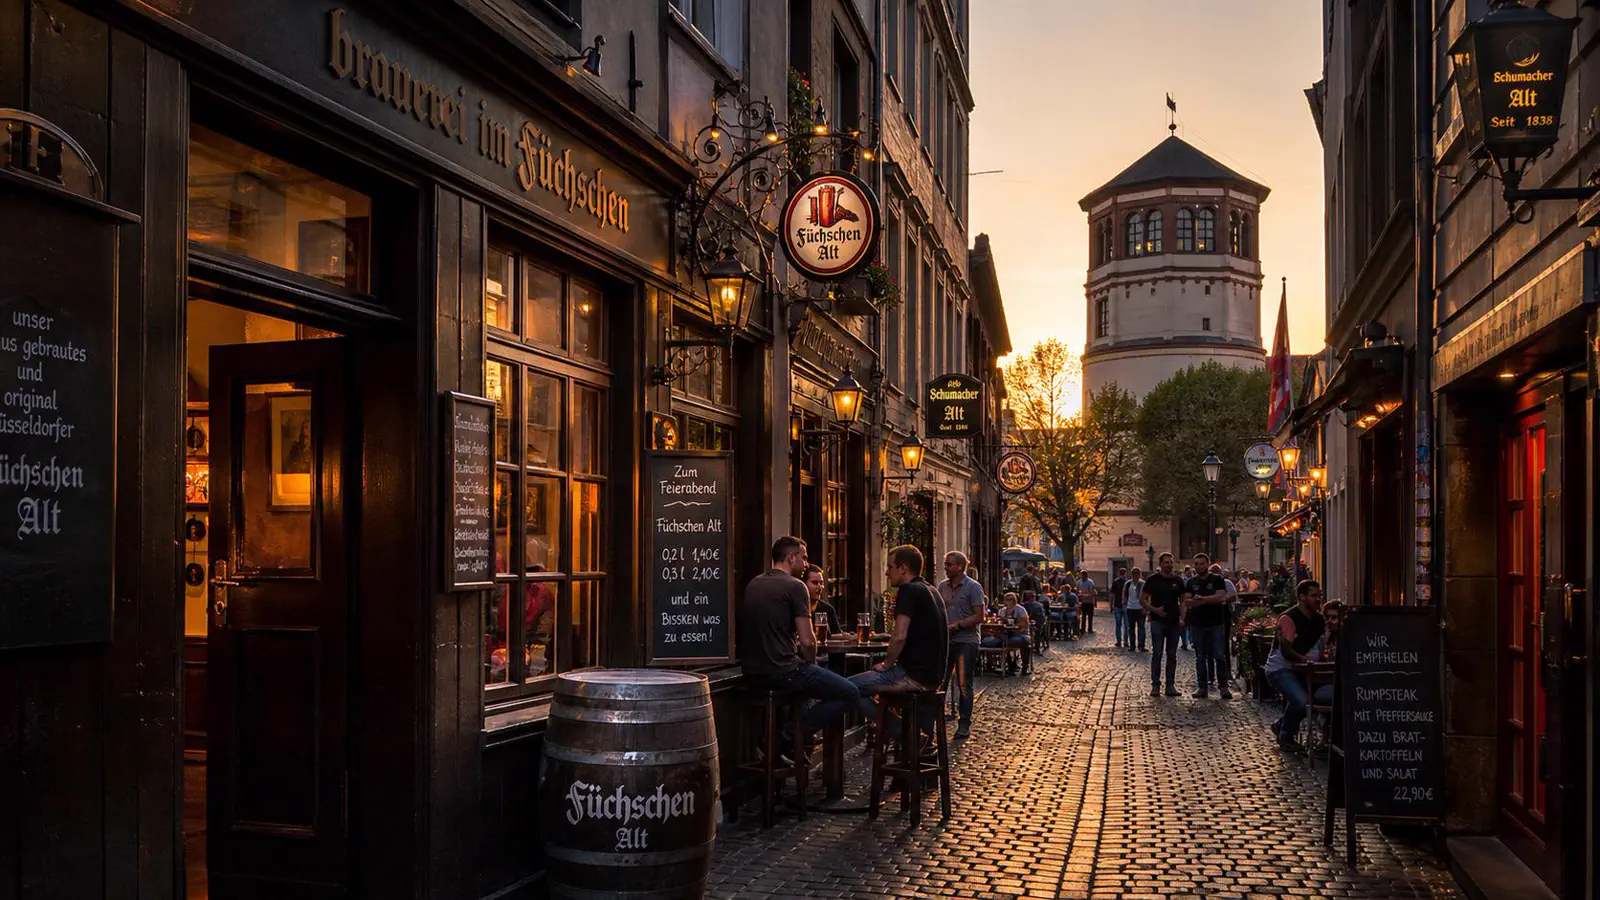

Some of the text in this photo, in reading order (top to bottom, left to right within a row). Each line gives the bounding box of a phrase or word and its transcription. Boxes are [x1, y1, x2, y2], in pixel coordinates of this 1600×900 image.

[1493, 70, 1554, 83] Schumacher
[1508, 88, 1537, 108] Alt
[328, 8, 629, 233] brauerei im Füchschen
[1491, 115, 1553, 128] Seit 1838
[796, 227, 861, 248] Füchschen
[817, 244, 840, 260] Alt
[12, 311, 54, 331] unser
[0, 335, 87, 362] us gebrautes
[17, 362, 43, 382] und
[4, 387, 58, 414] original
[929, 387, 979, 402] Schumacher
[944, 405, 965, 421] Alt
[0, 412, 75, 443] üsseldorfer
[0, 453, 84, 493] üchschen
[674, 465, 698, 478] Zum
[659, 480, 717, 494] Feierabend
[17, 497, 62, 541] Alt
[656, 517, 722, 533] Füchschen Alt
[661, 547, 678, 564] 0,2
[691, 547, 720, 564] 1,40€
[661, 566, 678, 583] 0,3
[671, 591, 709, 605] und ein
[702, 615, 721, 625] was
[664, 627, 713, 643] zu essen!
[1366, 632, 1390, 648] WIR
[1356, 686, 1419, 701] RUMPSTEAK
[1358, 730, 1426, 743] DAZU BRAT-
[1360, 750, 1423, 762] KARTOFFELN
[1361, 767, 1418, 780] UND SALAT
[1394, 786, 1434, 803] 22,90€
[565, 780, 695, 826] Füchschen
[615, 827, 649, 852] Alt
